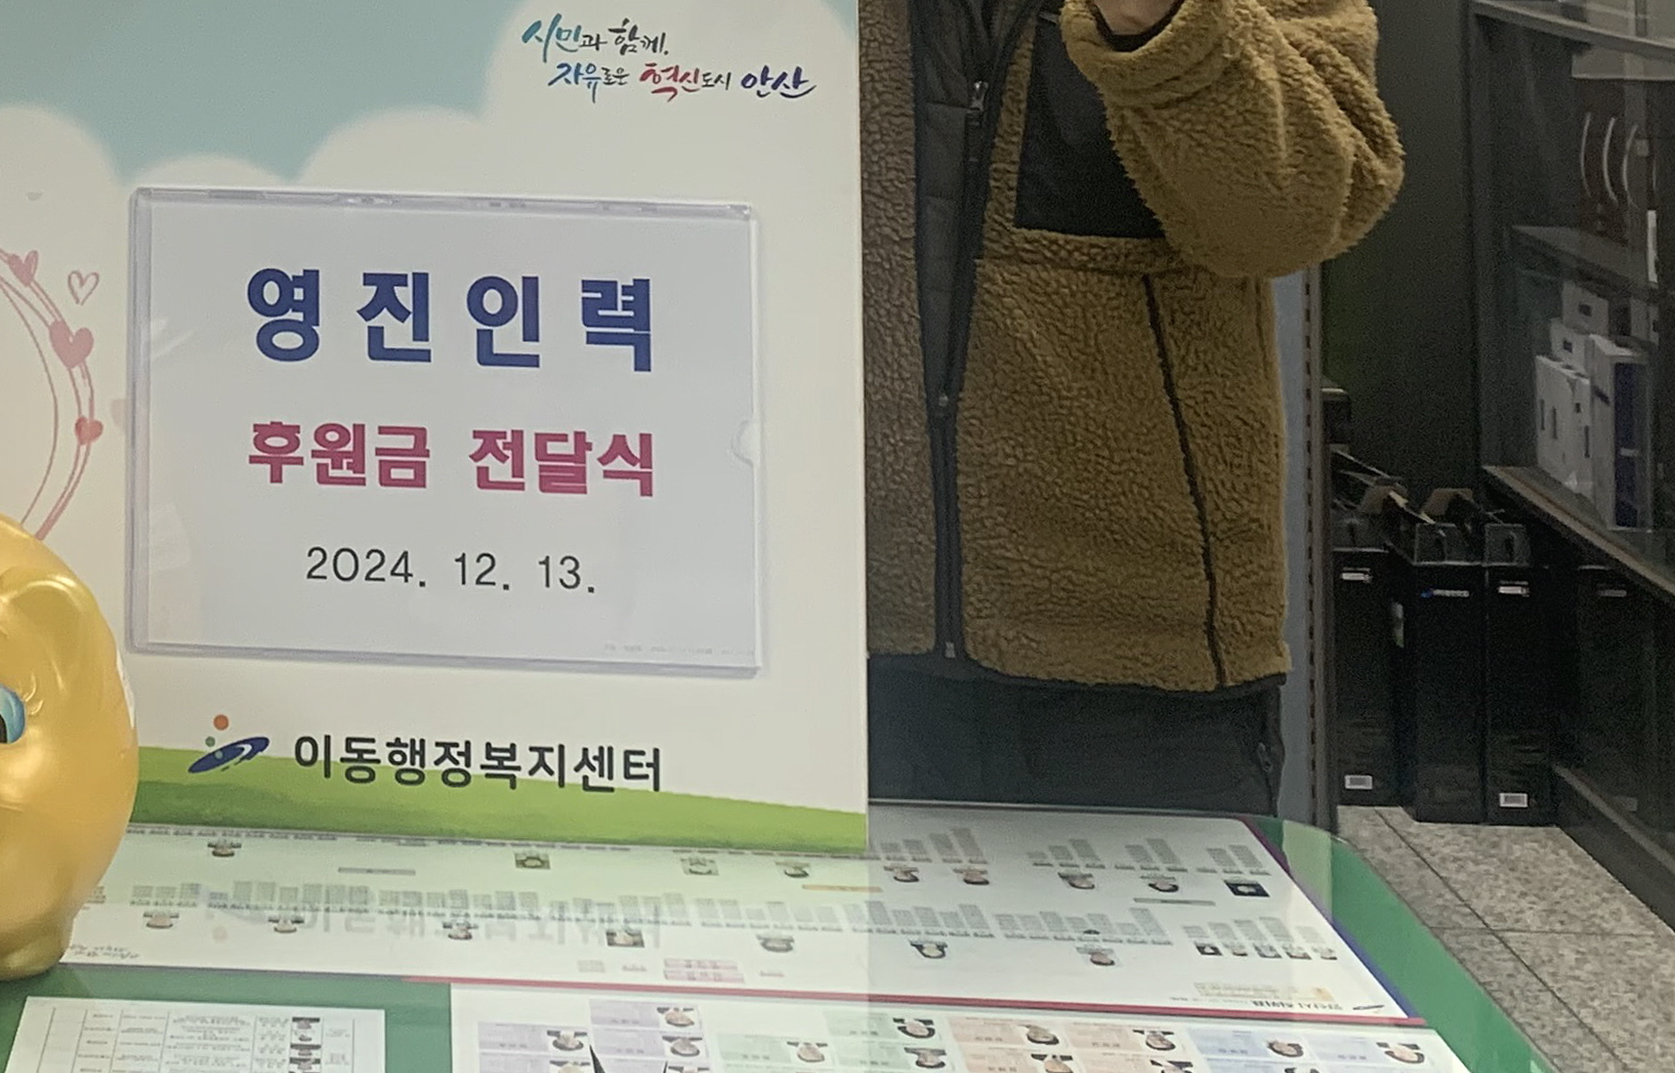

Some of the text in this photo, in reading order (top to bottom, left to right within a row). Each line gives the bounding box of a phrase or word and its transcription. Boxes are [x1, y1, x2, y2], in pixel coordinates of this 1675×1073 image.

[521, 13, 607, 63] 시민과
[548, 62, 818, 104] 자유로운 혁신도시 안산
[248, 420, 655, 498] 후원금 전달식
[306, 546, 597, 594] 2024. 12. 13.
[294, 734, 662, 793] 이동행정복지센터
